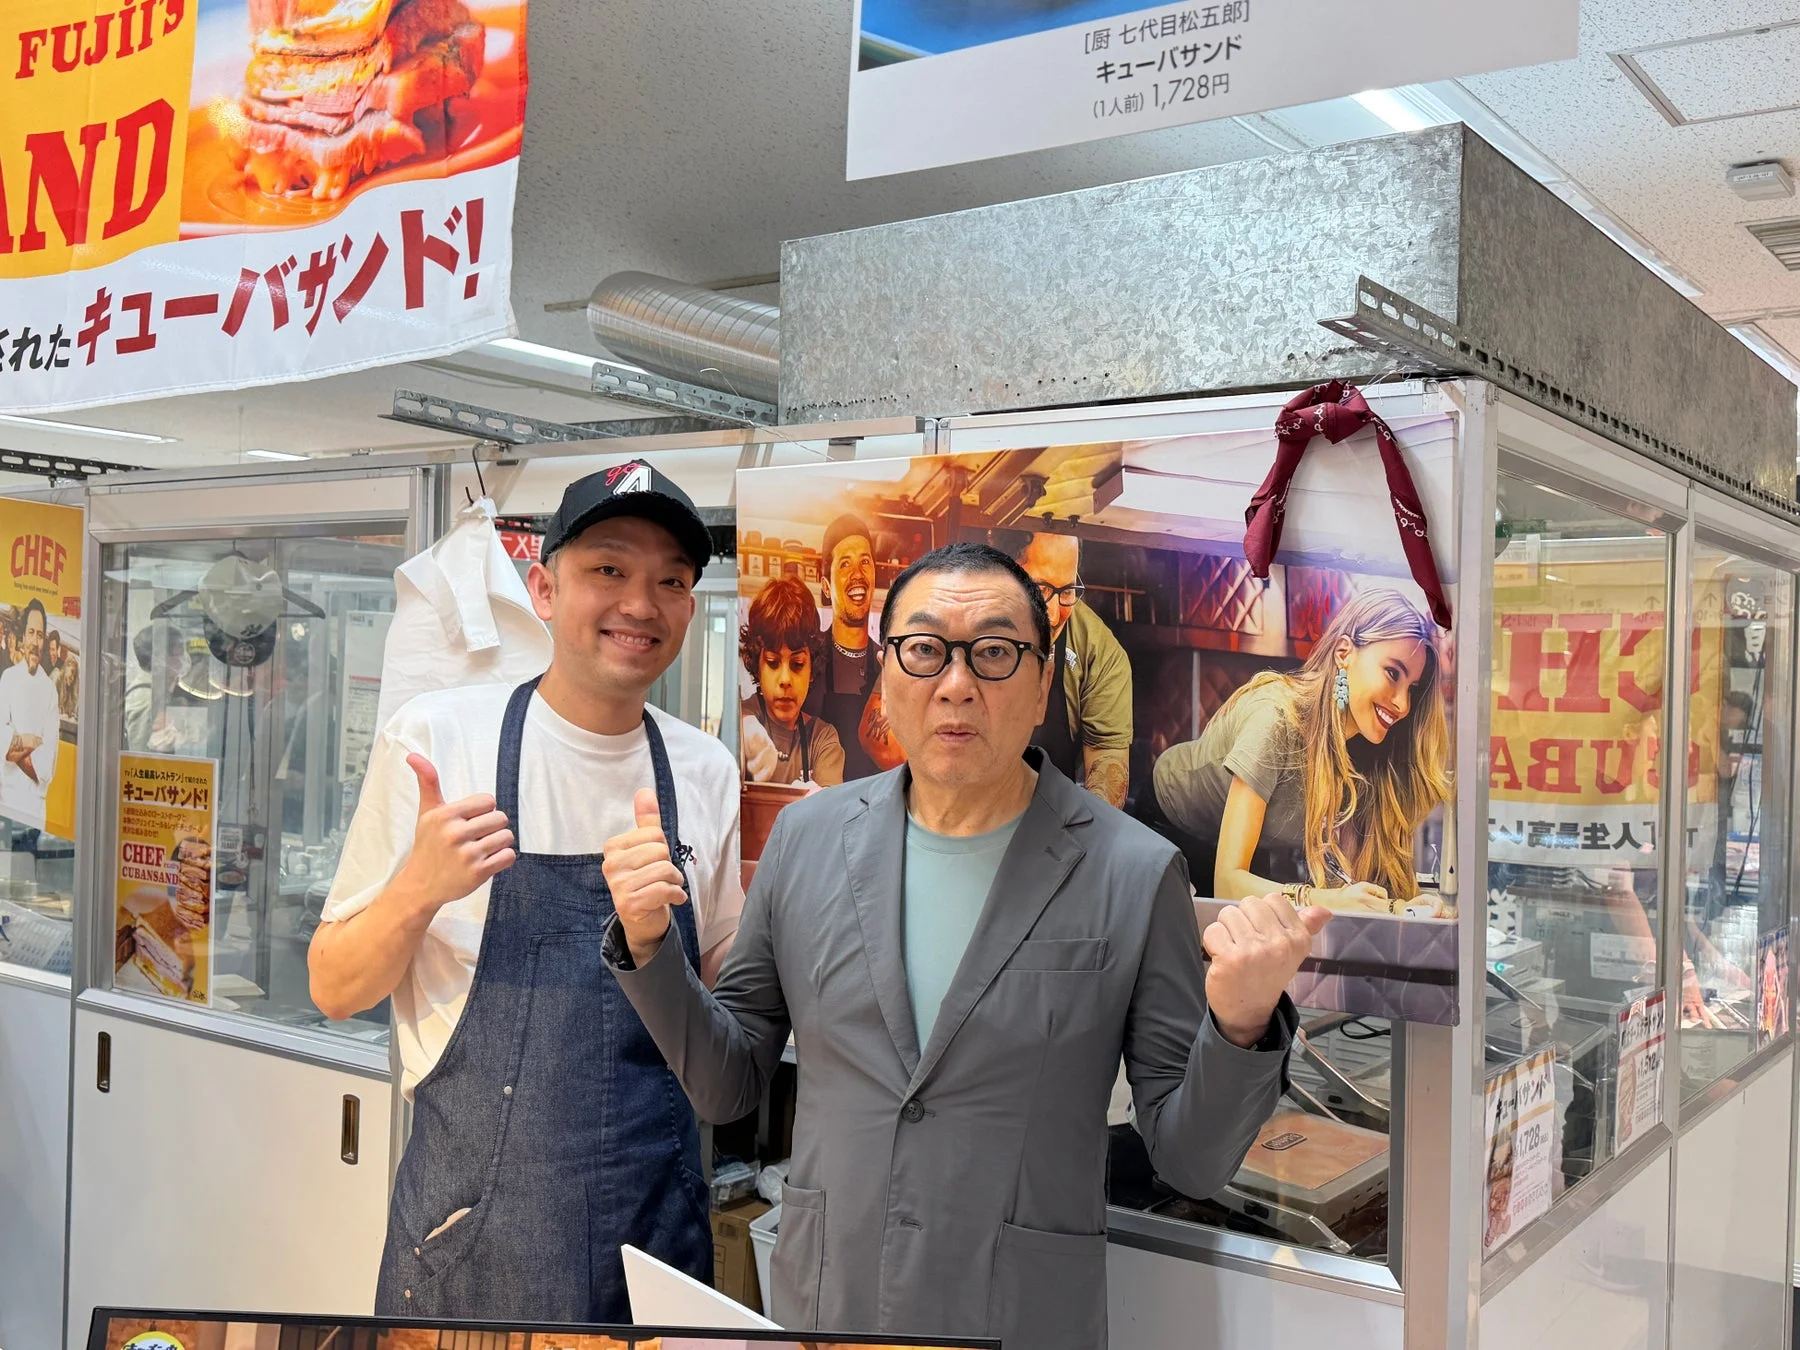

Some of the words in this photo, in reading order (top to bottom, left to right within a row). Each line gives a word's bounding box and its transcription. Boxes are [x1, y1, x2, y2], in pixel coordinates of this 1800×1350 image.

[15, 0, 185, 79] FUJIIS
[1096, 34, 1243, 83] キューバサンド
[1093, 92, 1145, 119] (1人前)
[1152, 73, 1230, 110] 1,728円
[10, 534, 67, 586] CHEF
[123, 780, 209, 810] キューバサンド!
[122, 842, 165, 867] CHEF
[122, 866, 179, 885] CUBANSAND
